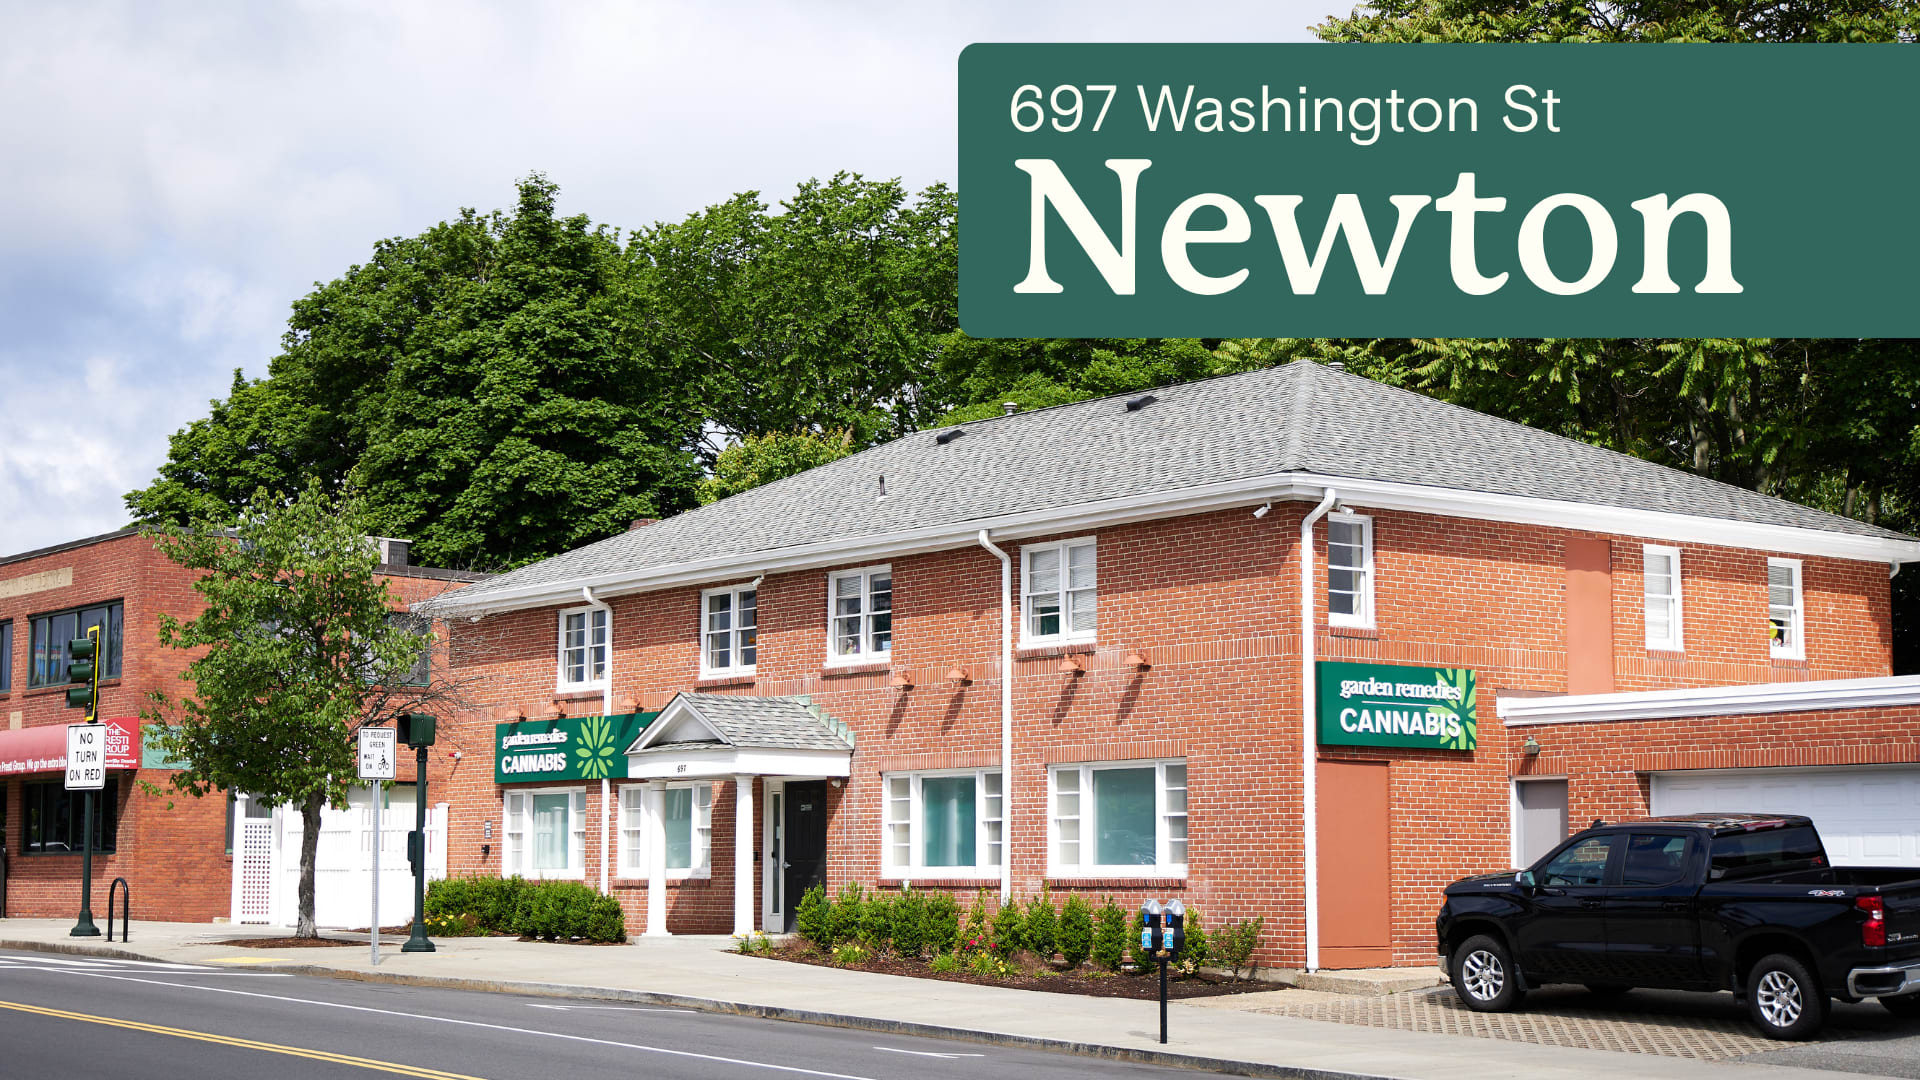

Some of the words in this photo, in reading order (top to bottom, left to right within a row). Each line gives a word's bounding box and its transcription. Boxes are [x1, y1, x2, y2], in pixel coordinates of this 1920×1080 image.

[1340, 677, 1393, 699] garden
[1395, 679, 1462, 701] remedies
[1339, 707, 1461, 738] CANNABIS
[79, 732, 94, 745] NO
[108, 728, 121, 736] THE
[370, 731, 393, 739] REQUEST
[106, 735, 129, 745] RESTI
[369, 741, 386, 749] GREEN
[106, 744, 130, 754] ROUP
[75, 750, 98, 763] TURN
[501, 752, 567, 774] CANNABIS
[69, 769, 81, 782] ON
[84, 768, 101, 781] RED
